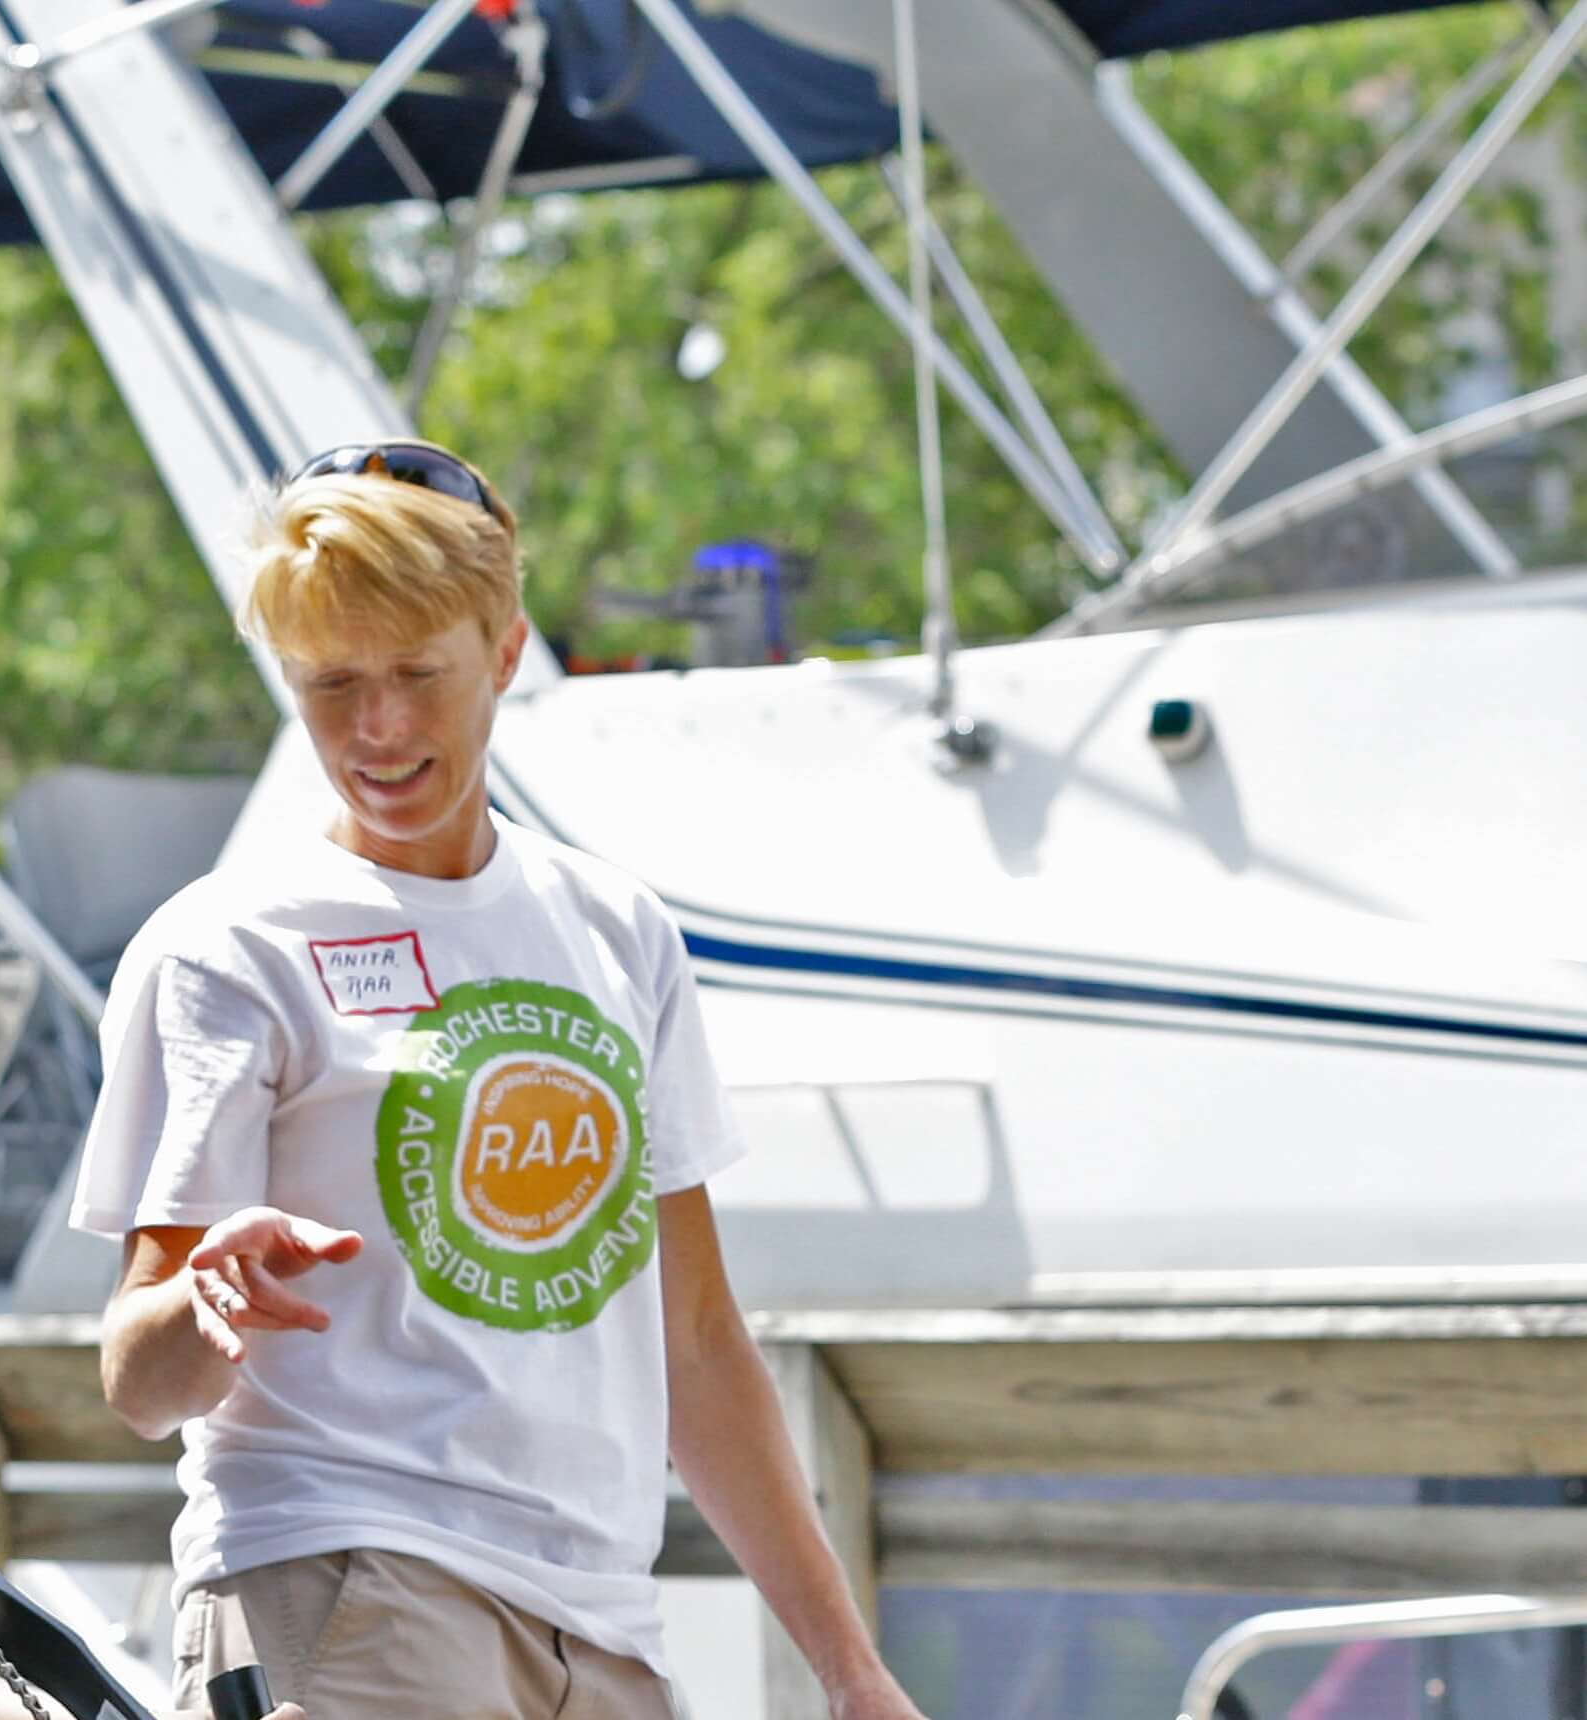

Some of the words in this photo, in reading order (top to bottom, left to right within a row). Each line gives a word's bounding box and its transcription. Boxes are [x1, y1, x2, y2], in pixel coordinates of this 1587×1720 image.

[418, 1002, 619, 1081] ROCHESTER
[476, 1114, 602, 1174] RAA
[397, 1106, 520, 1312] ACCESSIBLE
[535, 1088, 655, 1313] ADVENTUR
